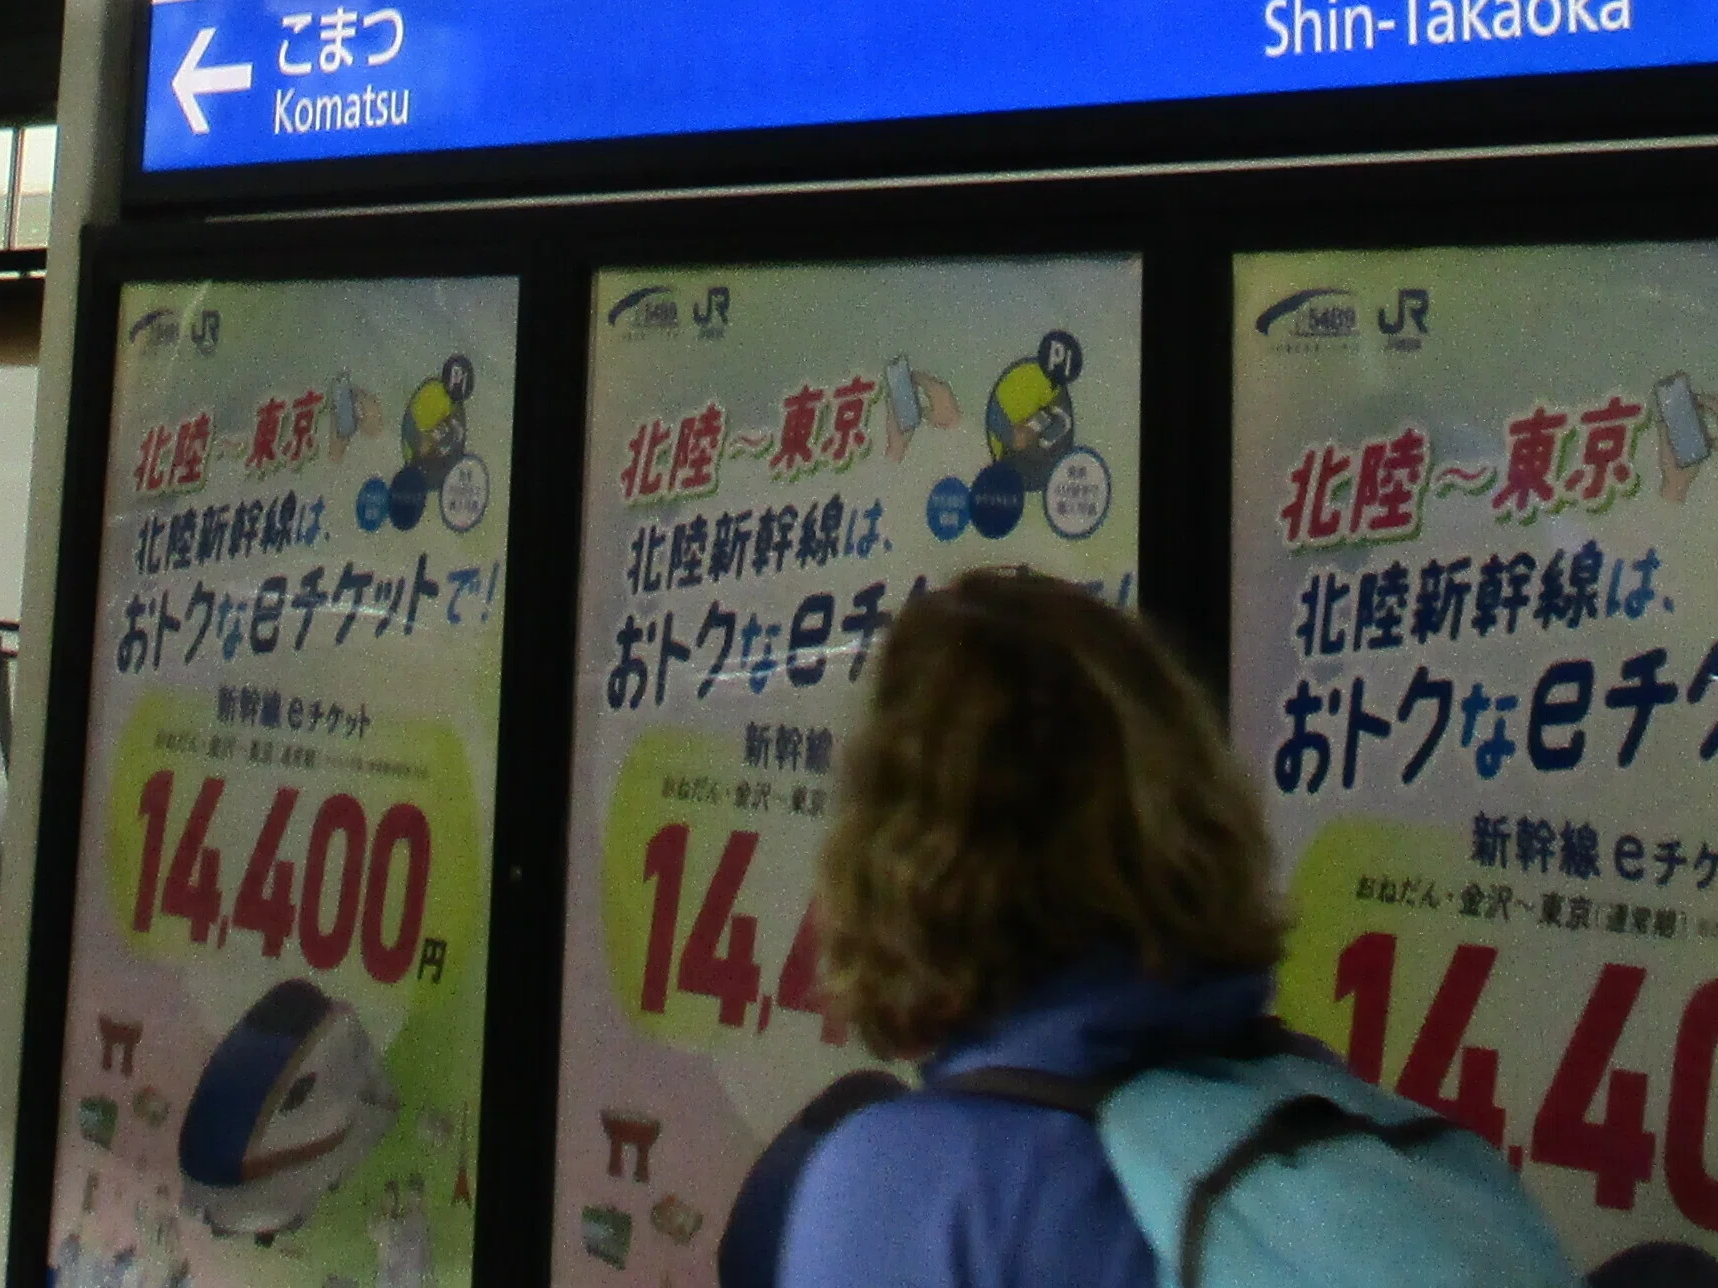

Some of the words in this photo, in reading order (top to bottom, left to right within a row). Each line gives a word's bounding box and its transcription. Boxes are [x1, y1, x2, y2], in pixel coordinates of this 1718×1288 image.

[276, 6, 405, 76] こまつ
[273, 84, 411, 135] Komatsu
[692, 285, 731, 326] JR
[1377, 288, 1430, 335] JR
